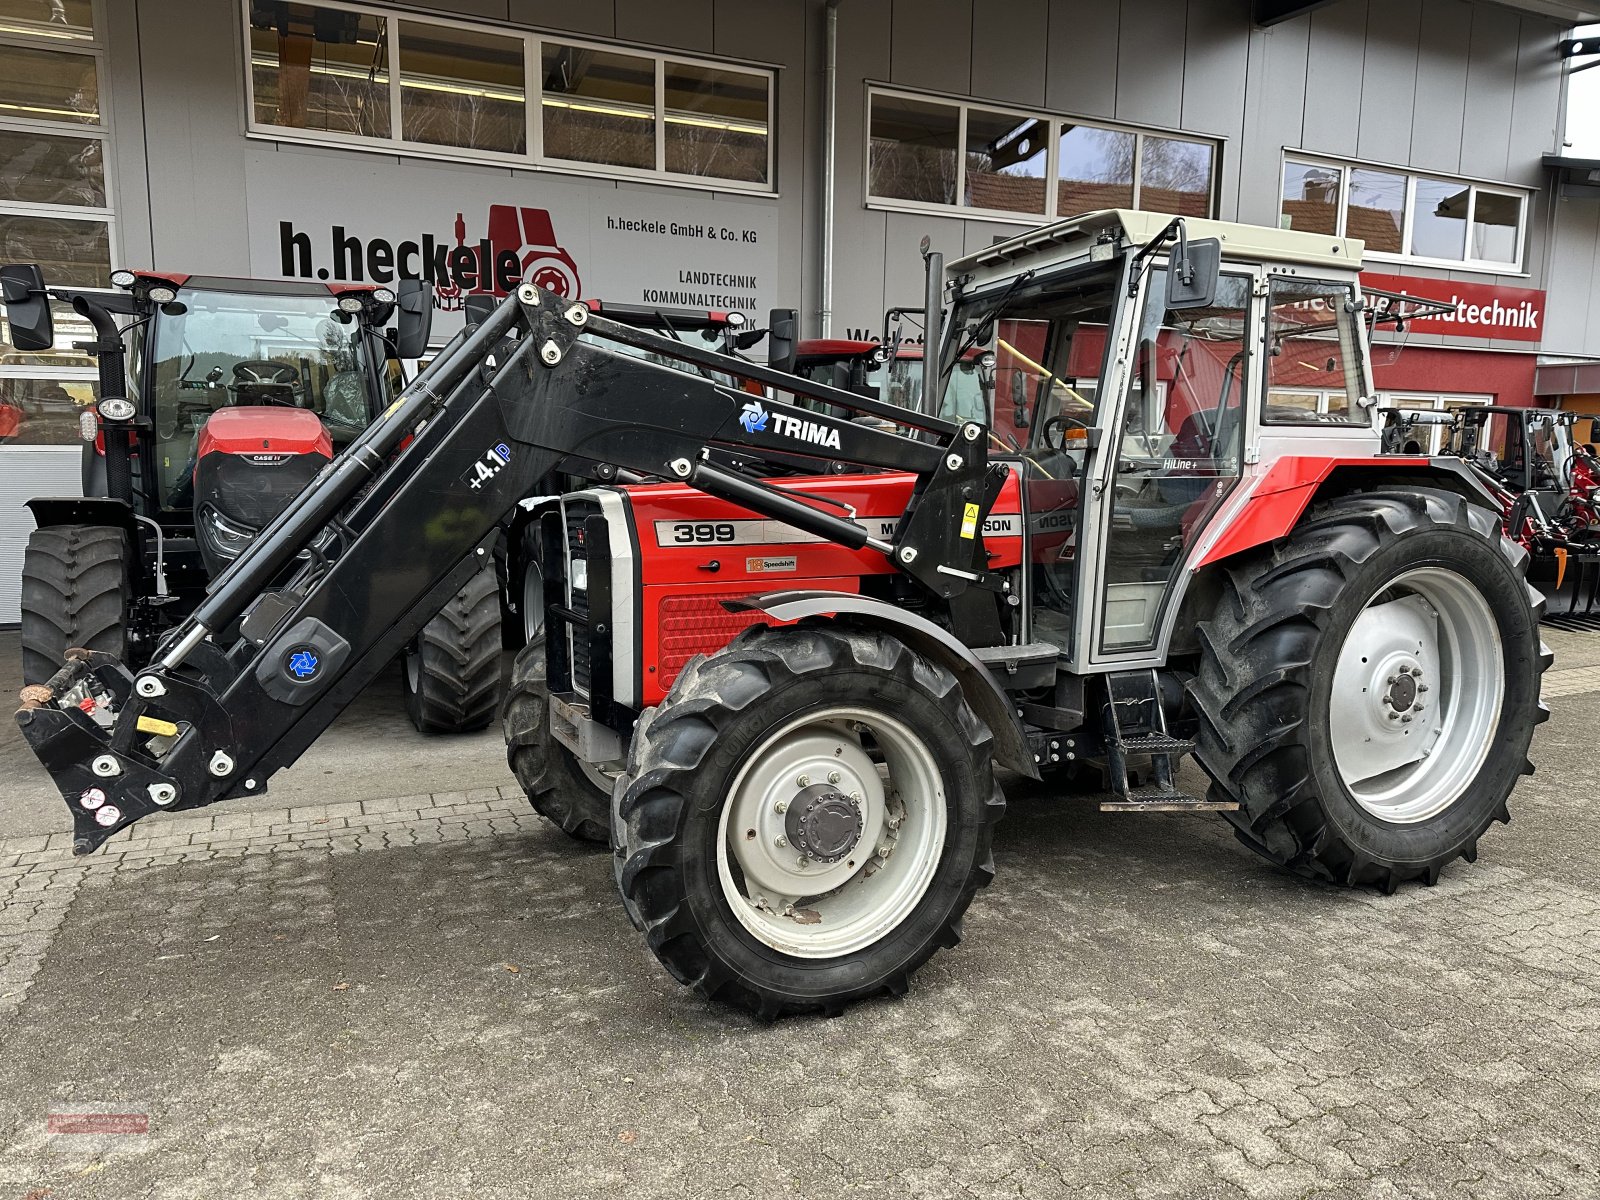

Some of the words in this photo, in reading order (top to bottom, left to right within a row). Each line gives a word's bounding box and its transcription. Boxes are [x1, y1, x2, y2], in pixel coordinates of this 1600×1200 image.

[607, 216, 666, 234] h.heckele
[670, 222, 704, 238] GmbH
[707, 226, 717, 239] &
[720, 227, 738, 241] Co.
[742, 229, 757, 243] KG
[280, 221, 522, 292] h.heckele
[679, 270, 757, 289] LANDTECHNIK
[643, 289, 757, 310] KOMMUNALTECHNIK
[771, 412, 841, 450] TRIMA
[673, 523, 735, 543] 399
[747, 559, 764, 572] 18
[763, 560, 795, 569] Speedshift
